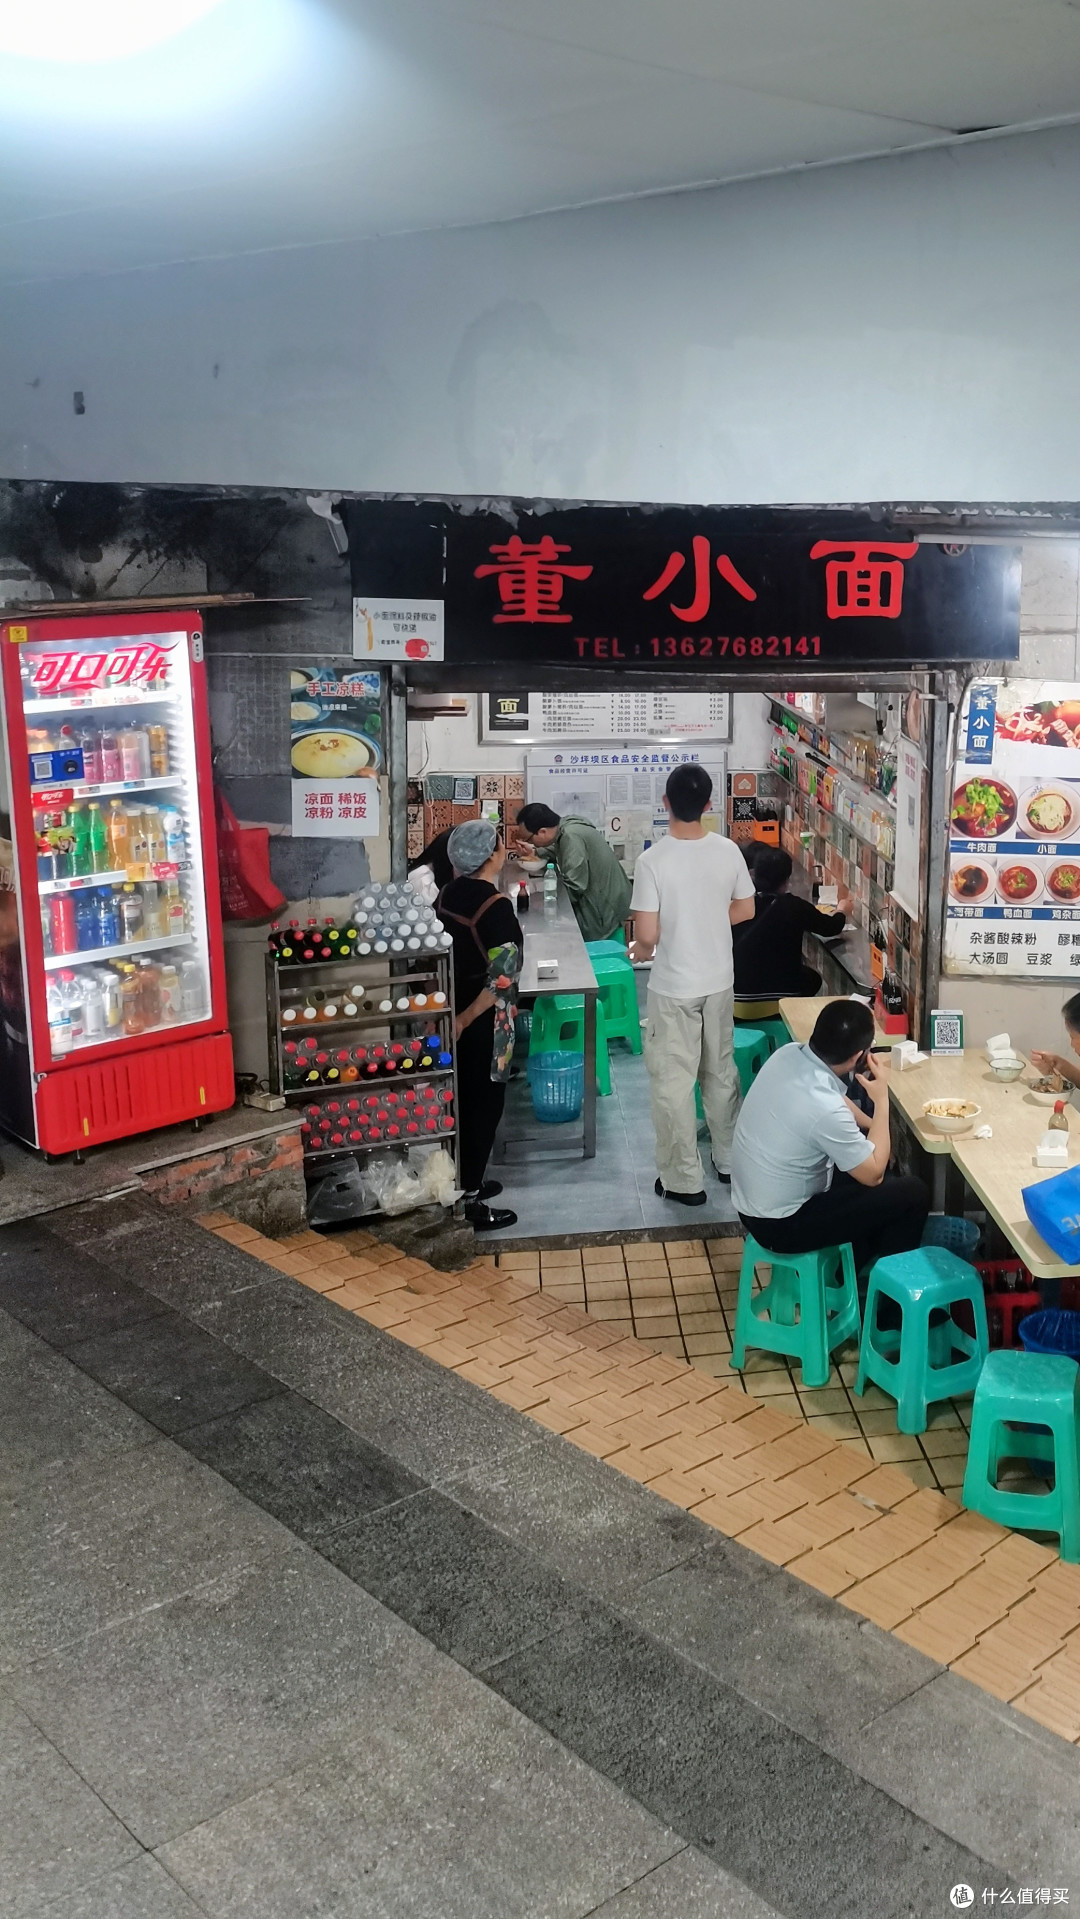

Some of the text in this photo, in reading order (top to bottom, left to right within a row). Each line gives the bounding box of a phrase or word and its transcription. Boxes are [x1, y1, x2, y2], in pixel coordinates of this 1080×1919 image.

[474, 534, 919, 624] 董小面
[650, 636, 822, 657] 13627682141
[33, 641, 180, 694] 可口可乐
[306, 681, 365, 697] 手工凉糕
[972, 696, 991, 748] 董小面
[570, 753, 700, 764] 沙坪坝区食品安全监督公示栏
[304, 792, 367, 805] 凉面 稀饭
[304, 806, 367, 819] 凉粉 凉皮
[611, 816, 621, 832] C
[966, 842, 997, 853] 牛肉面
[1037, 844, 1058, 854] 小面
[1003, 908, 1033, 919] 鸭血面
[969, 932, 1037, 946] 杂酱酸辣粉
[968, 951, 1009, 965] 大汤圆
[1026, 952, 1053, 966] 豆浆
